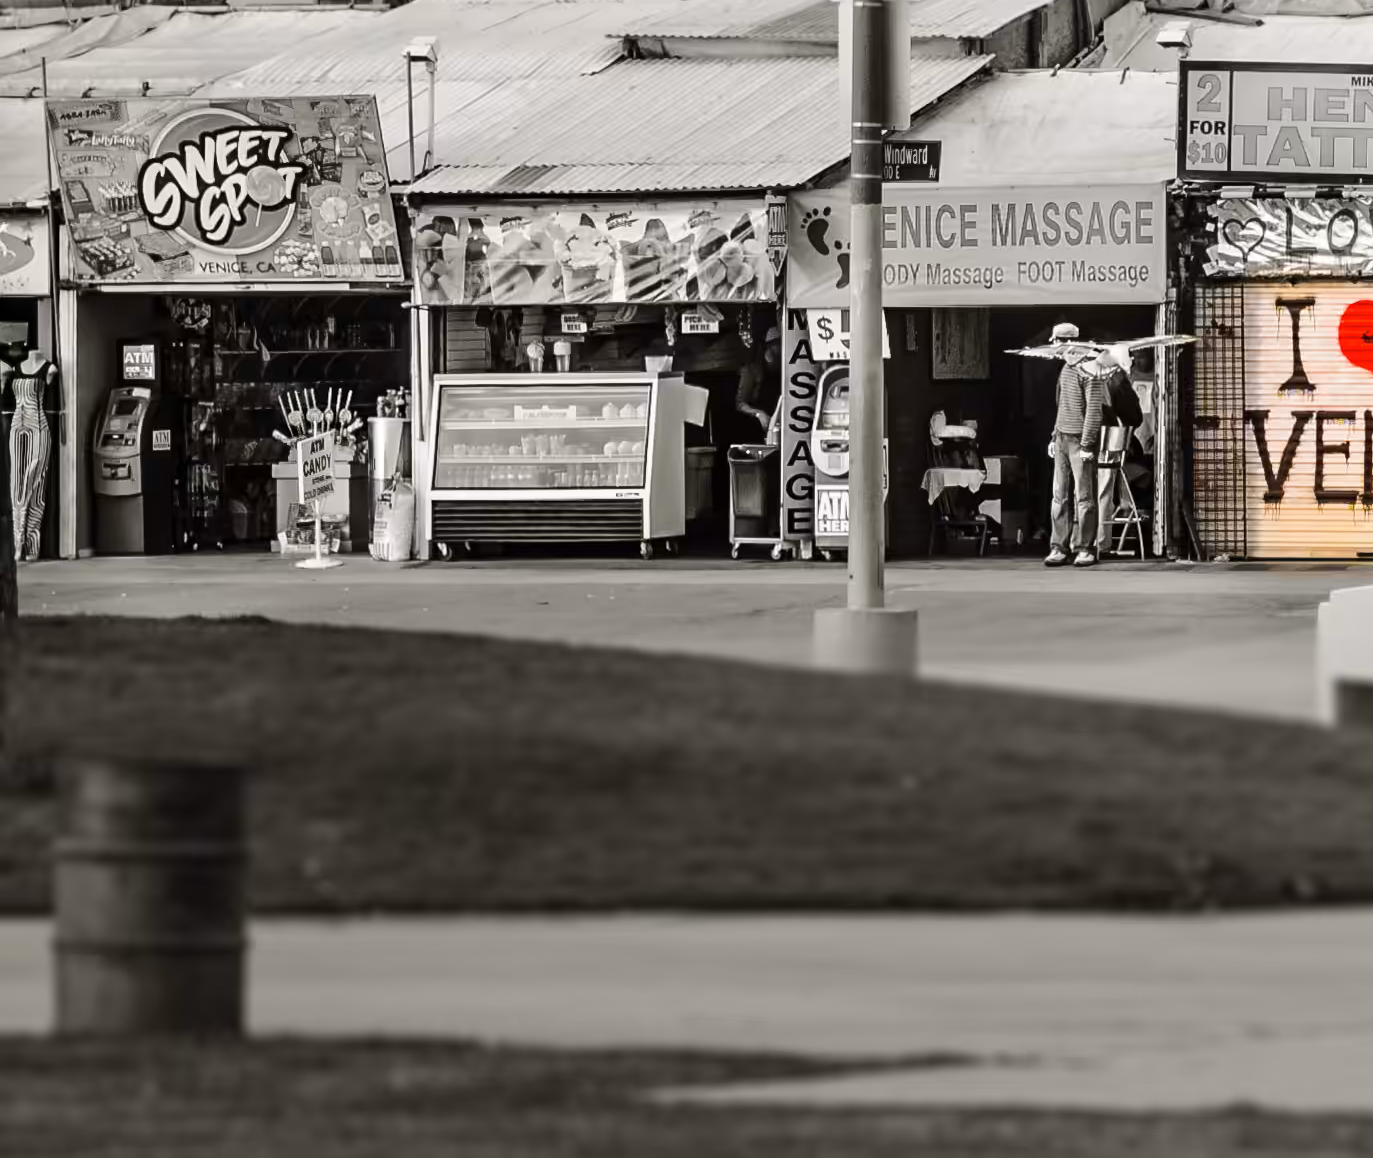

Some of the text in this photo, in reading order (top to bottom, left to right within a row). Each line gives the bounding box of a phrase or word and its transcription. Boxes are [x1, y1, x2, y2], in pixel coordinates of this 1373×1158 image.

[1196, 74, 1222, 113] 2
[1190, 120, 1227, 136] FOR
[884, 144, 928, 164] Windward
[1187, 139, 1228, 165] $10
[142, 129, 289, 226] SWEET
[882, 200, 1154, 248] ENICE MASSAGE
[256, 261, 277, 274] CA
[883, 260, 1149, 289] ODY Massage FOOT Massage
[1275, 296, 1317, 394] I
[124, 352, 154, 364] ATM
[786, 308, 817, 534] MASSAGE
[154, 431, 170, 443] ATM
[310, 437, 325, 455] ATM
[302, 453, 333, 478] CANDY
[818, 519, 849, 533] HER
